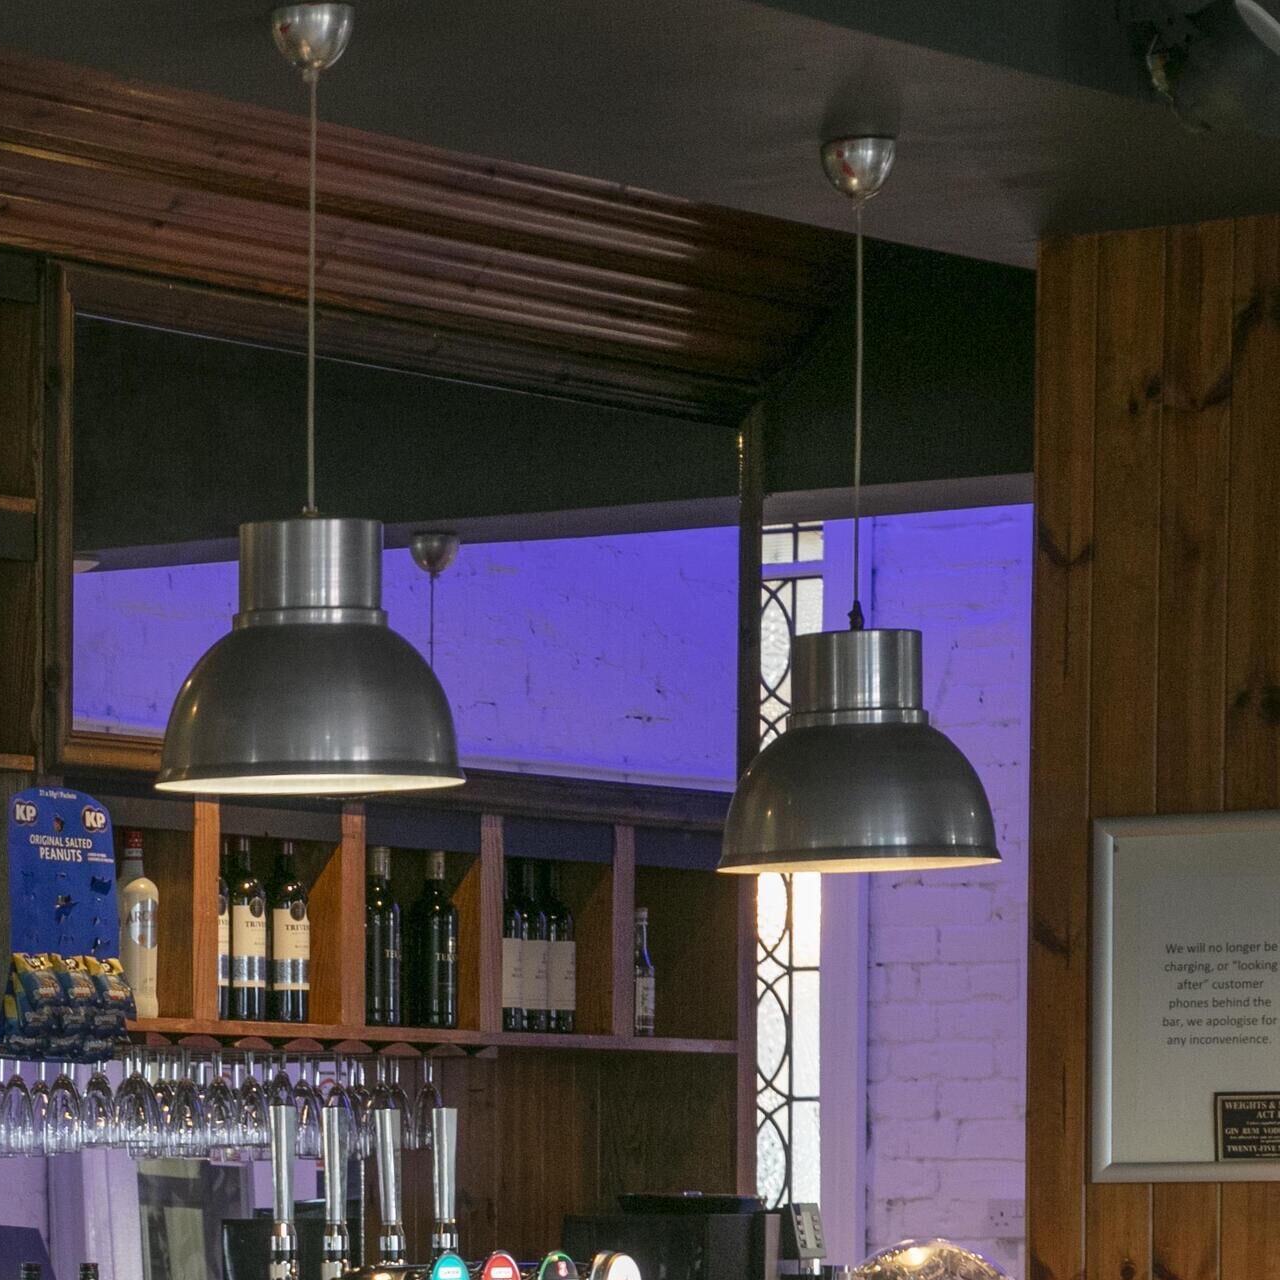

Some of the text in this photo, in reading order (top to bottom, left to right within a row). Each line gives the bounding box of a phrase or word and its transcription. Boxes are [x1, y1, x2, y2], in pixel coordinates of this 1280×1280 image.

[15, 804, 37, 821] KP
[85, 811, 107, 828] KP
[29, 834, 93, 850] ORIGINAL SALTED
[40, 846, 83, 862] PEANUTS
[1165, 941, 1278, 955] We will no longer be
[1164, 961, 1214, 974] charging,
[1216, 962, 1229, 971] or
[1211, 980, 1264, 990] customer
[1168, 996, 1272, 1010] phones behind the
[1162, 1014, 1277, 1028] bar, we apologise for
[1167, 1034, 1272, 1047] any inconvenience.
[1224, 1101, 1276, 1110] WEIGHTS &
[1256, 1110, 1275, 1119] ACT
